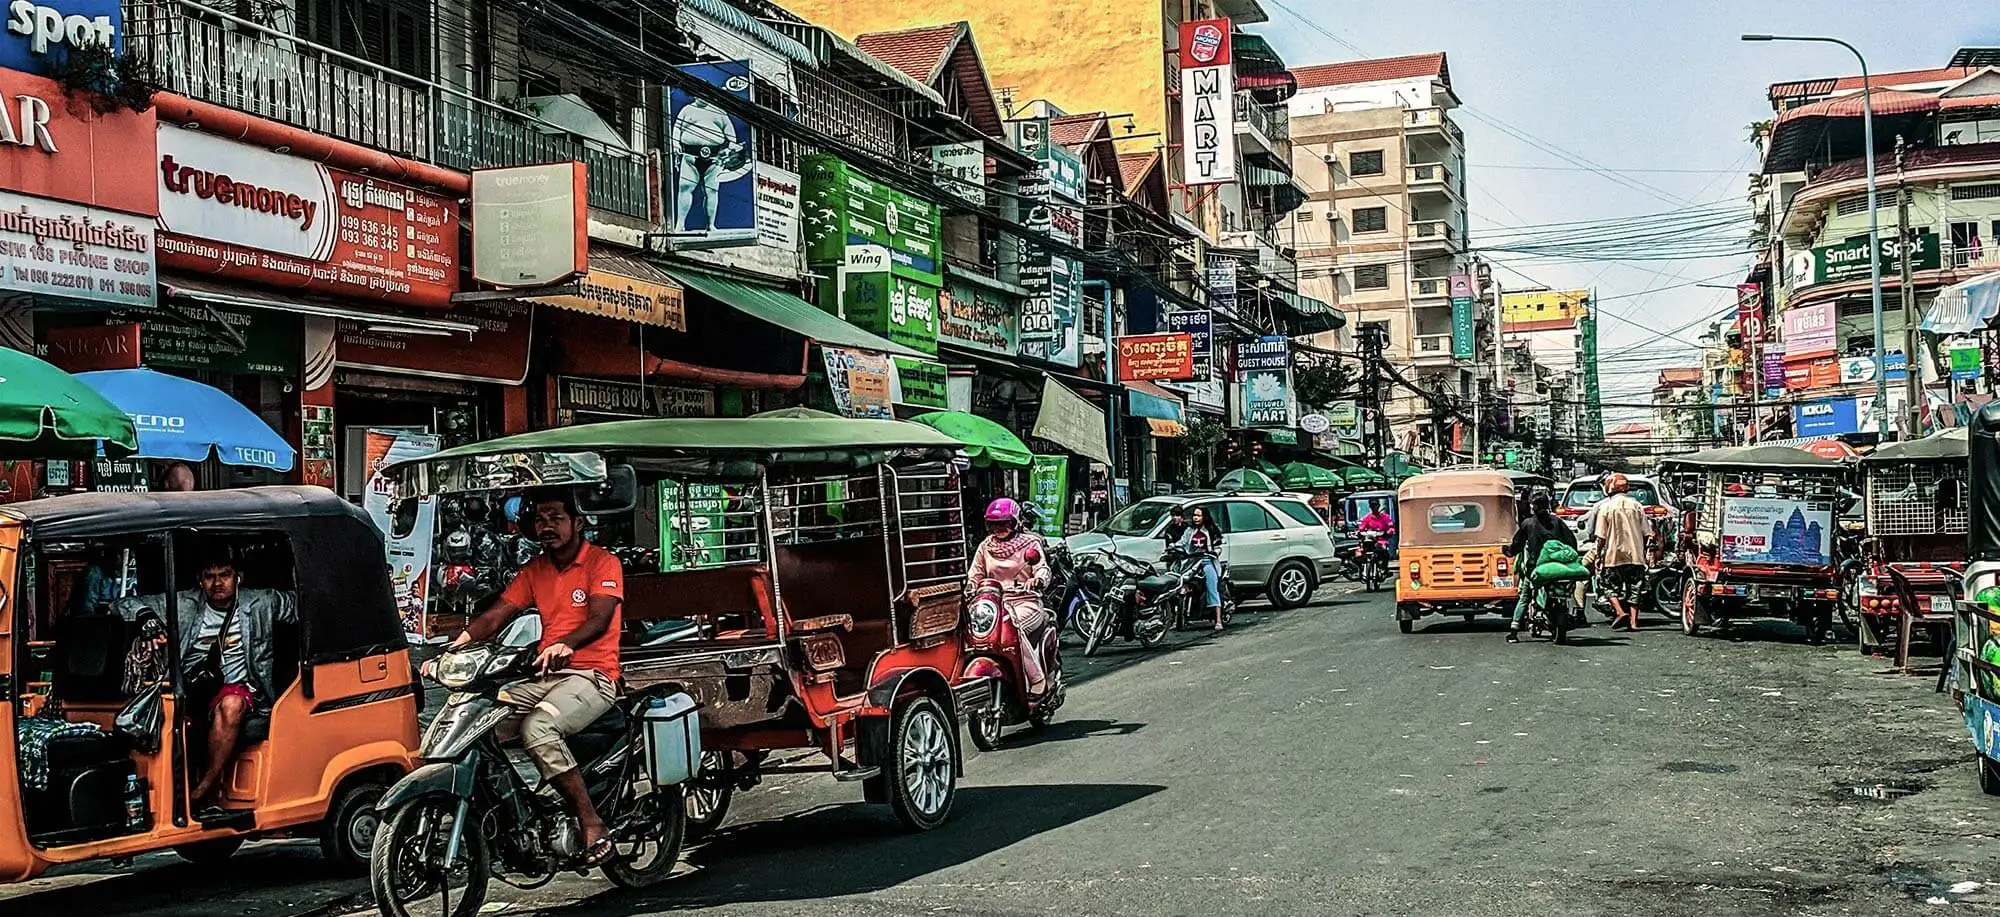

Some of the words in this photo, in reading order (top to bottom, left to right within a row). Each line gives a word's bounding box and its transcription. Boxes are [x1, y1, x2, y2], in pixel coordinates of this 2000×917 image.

[8, 0, 115, 54] spot
[1194, 69, 1221, 177] MART
[496, 174, 549, 187] truemoney
[161, 155, 316, 231] truemoney
[341, 215, 359, 230] 099
[362, 219, 379, 234] 636
[380, 223, 398, 238] 345
[342, 228, 359, 244] 093
[362, 233, 379, 248] 366
[381, 237, 399, 251] 345
[1825, 244, 1870, 264] Smart
[1882, 237, 1925, 258] Spot
[60, 249, 108, 270] PHONE
[114, 257, 150, 276] SHOP
[851, 254, 882, 268] Wing
[1743, 316, 1761, 336] 19
[55, 334, 129, 357] SUGAR
[1237, 357, 1260, 368] GUEST
[1261, 356, 1285, 367] HOUSE
[1251, 409, 1286, 422] MART
[234, 446, 276, 465] TECNO
